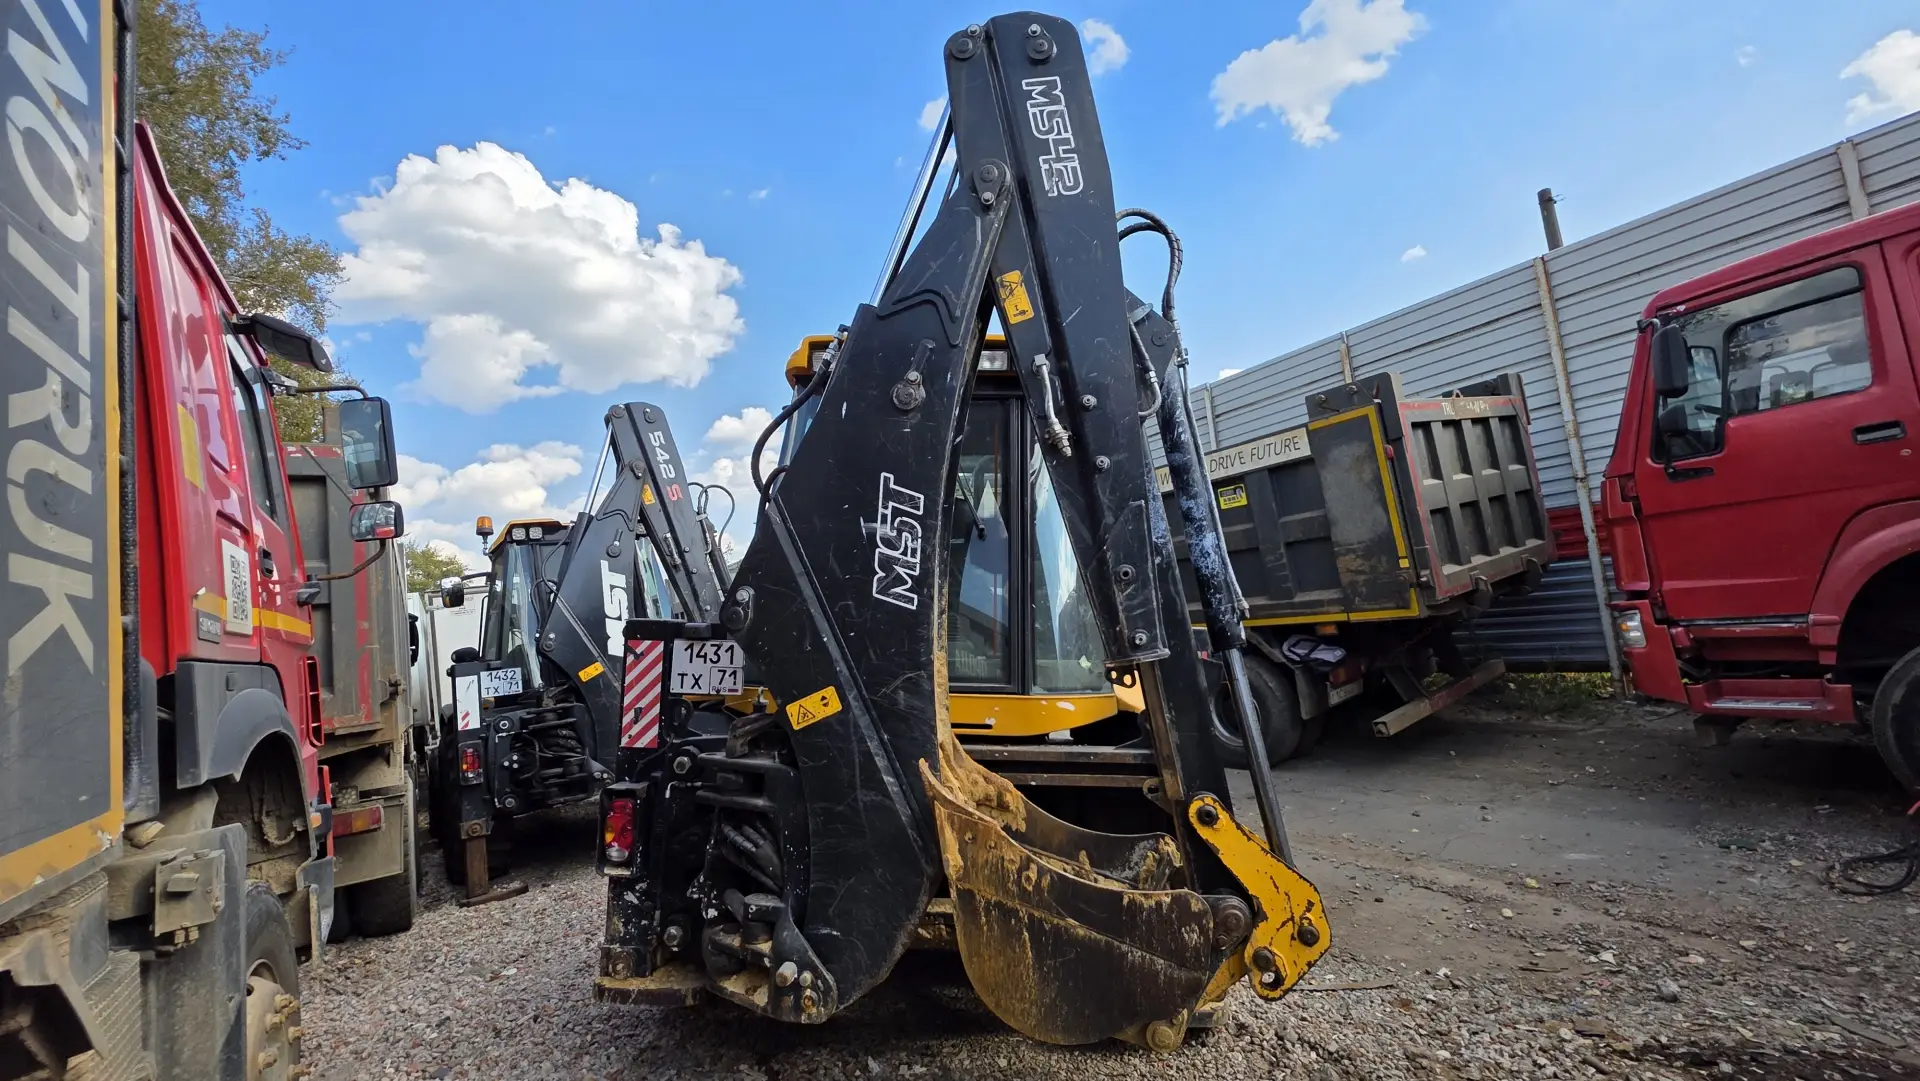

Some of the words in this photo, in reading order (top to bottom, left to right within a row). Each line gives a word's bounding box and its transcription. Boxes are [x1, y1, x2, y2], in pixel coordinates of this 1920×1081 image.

[648, 430, 676, 480] 542
[665, 483, 684, 502] S
[1209, 450, 1246, 473] DRIVE
[1250, 435, 1301, 463] FUTURE
[872, 471, 925, 610] MST
[600, 559, 629, 658] MST
[684, 642, 735, 666] 1431
[484, 686, 500, 696] TX
[507, 681, 520, 690] 71
[486, 669, 517, 683] 1432
[677, 672, 704, 690] TX
[717, 669, 738, 686] 71
